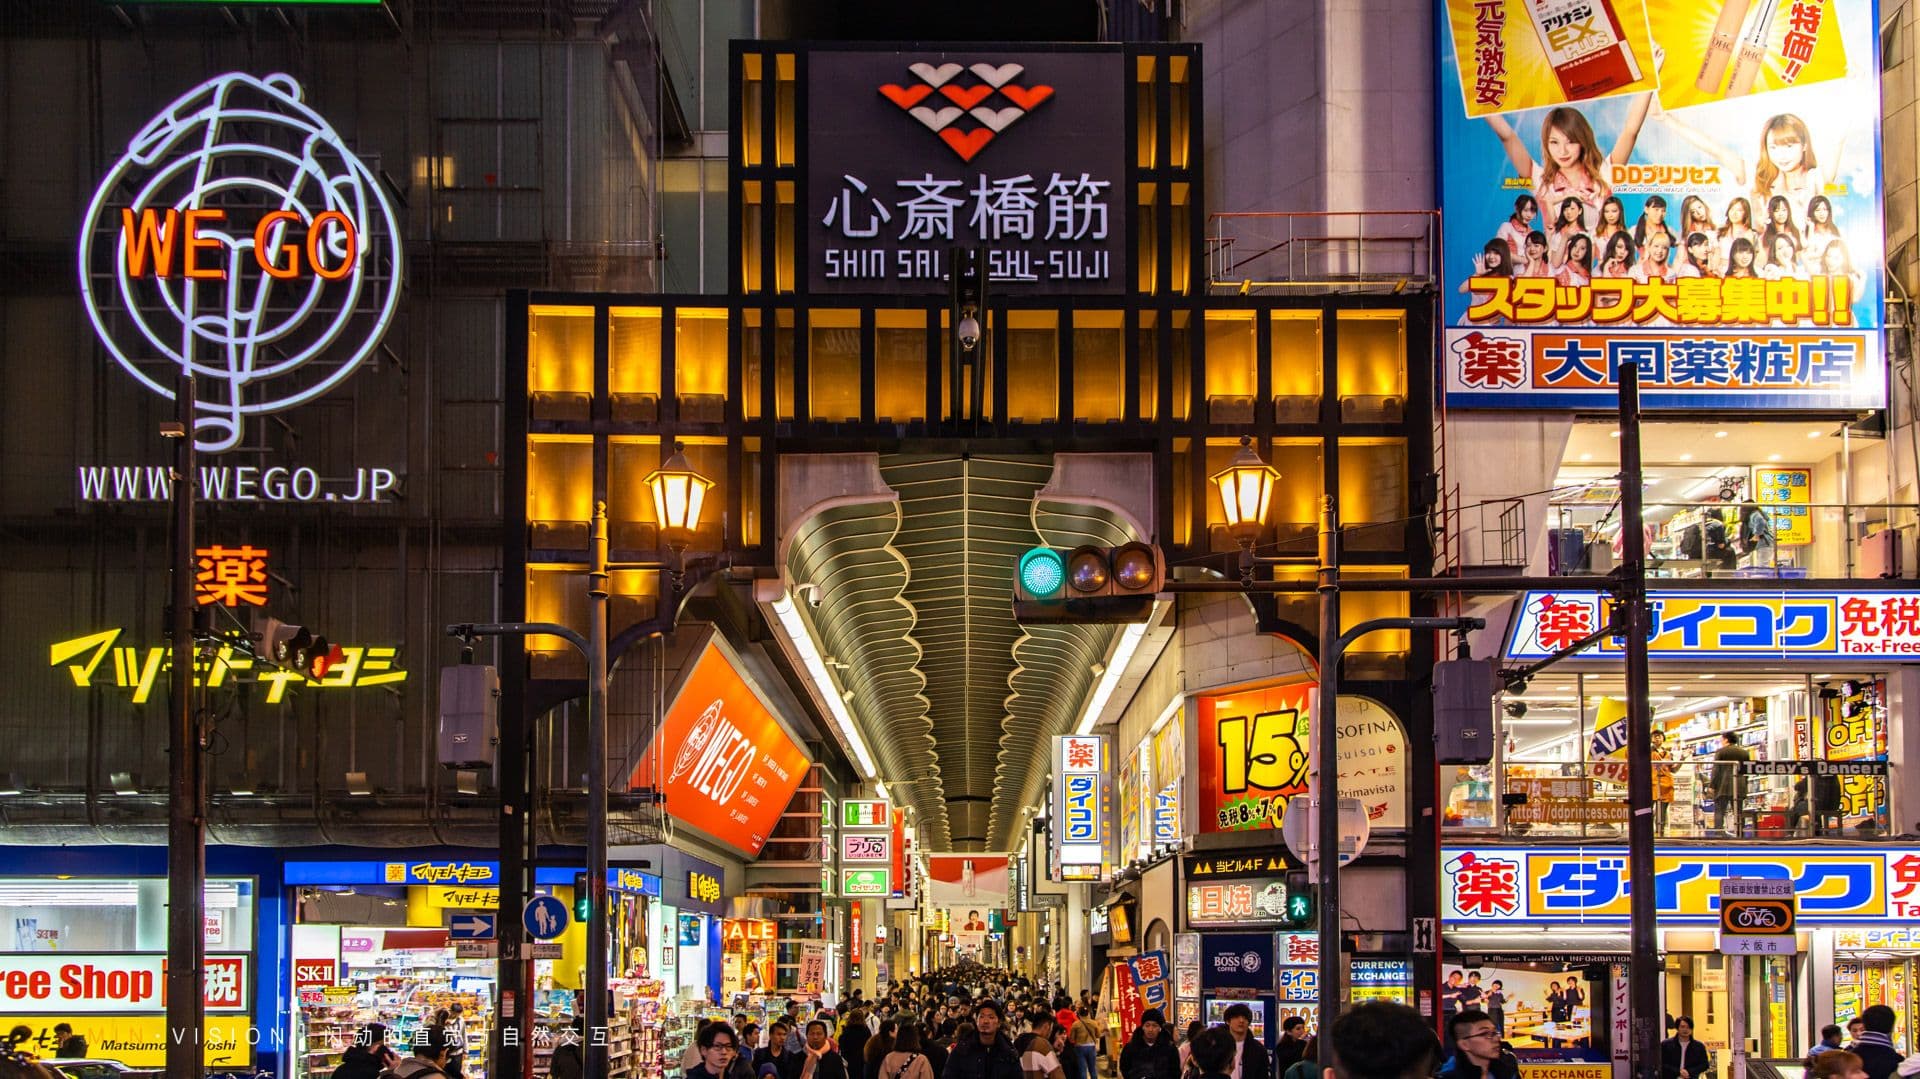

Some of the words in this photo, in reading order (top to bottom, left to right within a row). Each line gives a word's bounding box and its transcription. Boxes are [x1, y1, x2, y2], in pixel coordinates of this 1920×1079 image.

[1541, 6, 1593, 32] アリナミン
[1547, 16, 1599, 51] EX
[1611, 166, 1721, 184] DDプリンセス
[822, 173, 1111, 241] 心斎橋筋
[253, 209, 357, 279] GO
[825, 250, 885, 278] SHIN
[1468, 276, 1853, 326] スタッフ大募集中!!
[1455, 334, 1524, 390] 薬
[1544, 340, 1857, 386] 大国薬粧店
[195, 545, 269, 607] 薬
[1538, 598, 1593, 651] 薬
[1840, 597, 1920, 638] 免税
[1841, 639, 1920, 653] Tax-Free
[1336, 720, 1397, 740] SOFINA
[686, 717, 757, 807] WEGO
[1068, 738, 1095, 769] 薬
[1744, 761, 1810, 775] Today's
[1817, 761, 1882, 775] Dancer
[1337, 783, 1397, 800] Primavista
[1069, 776, 1094, 838] ダイコク
[412, 862, 493, 884] マツモトキヨシ
[1216, 859, 1264, 873] 当ビル4F
[1453, 853, 1520, 917] 薬
[1723, 884, 1793, 896] 自転車放置禁止区域
[1201, 885, 1252, 918] 日焼
[205, 927, 221, 936] ree
[1288, 935, 1319, 962] 薬
[1740, 940, 1778, 952] 大阪市
[296, 965, 334, 982] SK-II
[1214, 956, 1240, 967] BOSS
[1350, 961, 1406, 971] CURRENCY
[60, 962, 153, 1003] Shop
[204, 962, 238, 1002] 税
[1350, 972, 1407, 981] EXCHANGE
[1614, 978, 1628, 1043] レインボー
[1532, 1069, 1603, 1079] EXCHANGE
